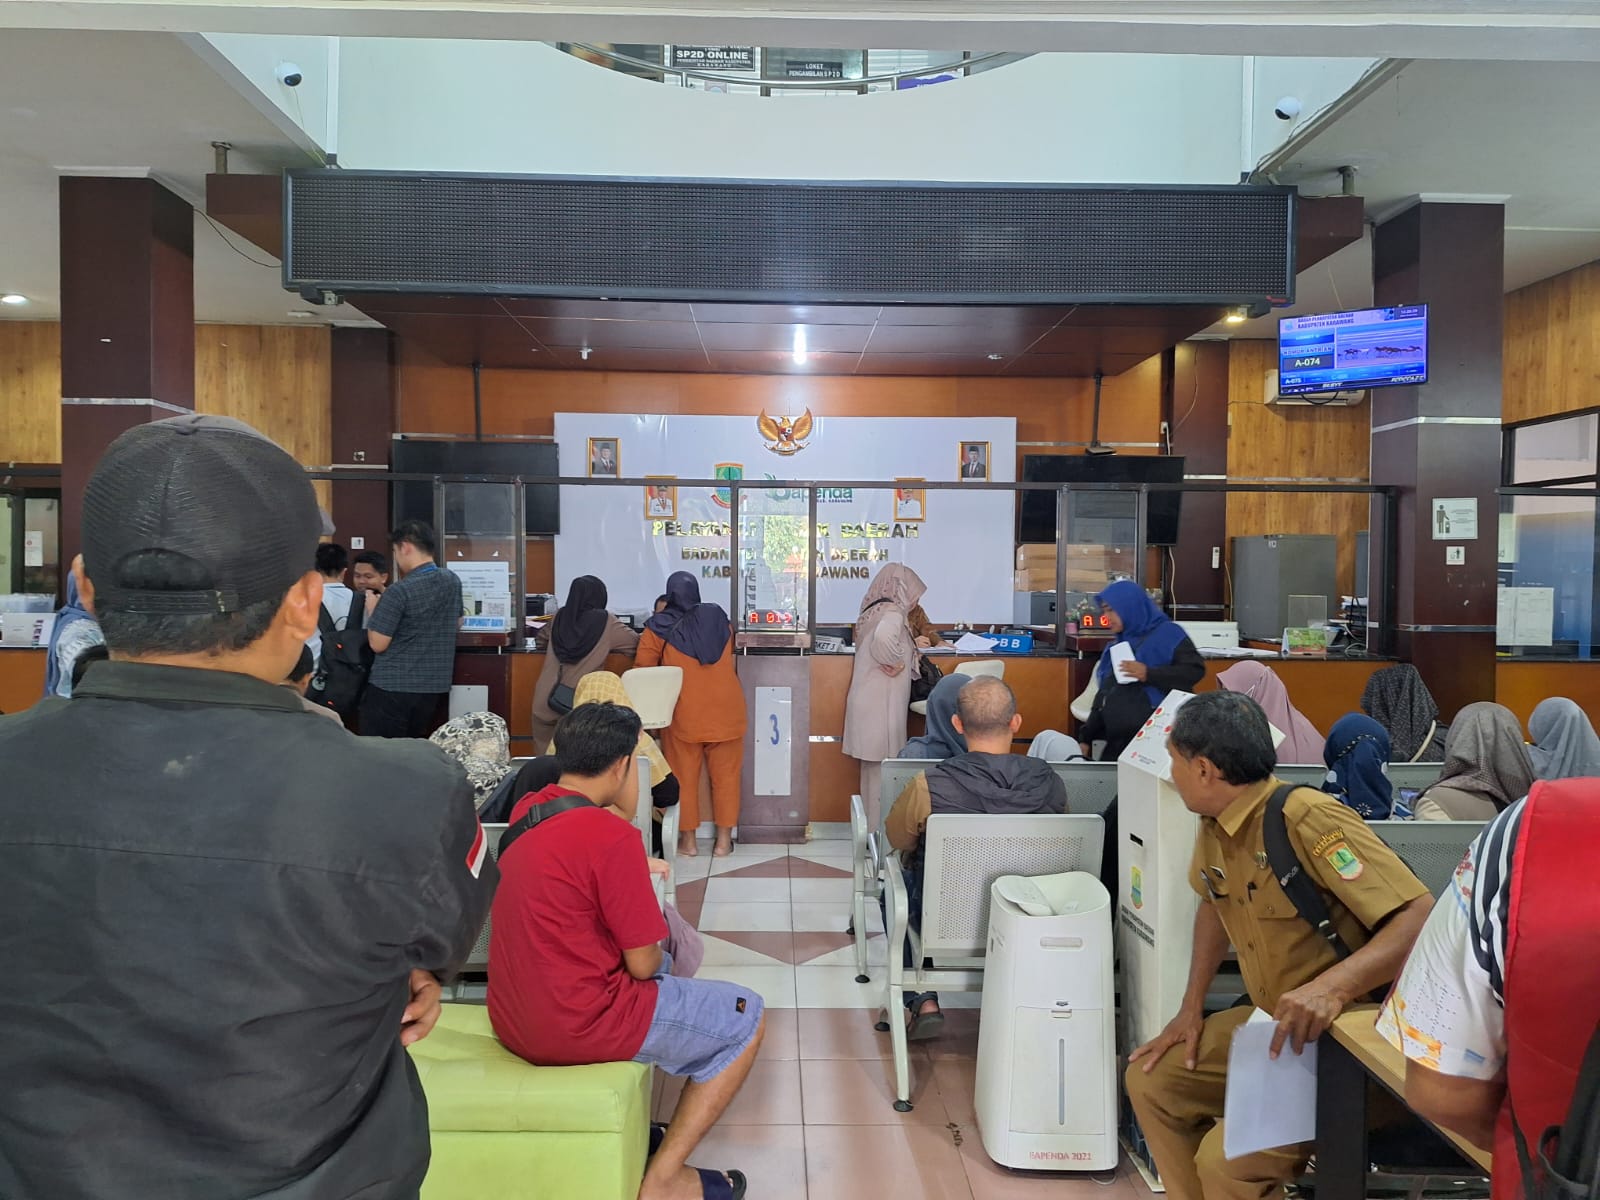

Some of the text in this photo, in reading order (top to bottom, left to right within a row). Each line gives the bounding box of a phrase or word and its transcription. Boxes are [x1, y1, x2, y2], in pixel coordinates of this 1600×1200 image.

[676, 50, 704, 58] SP2D
[707, 51, 749, 60] ONLINE
[1294, 358, 1320, 367] A-074
[841, 522, 919, 538] DAERAH
[682, 547, 729, 560] BADAN
[831, 549, 888, 561] DAERAH
[749, 612, 759, 623] A
[1083, 615, 1093, 626] A
[769, 714, 780, 745] 3
[1029, 1151, 1070, 1161] BAPENDA
